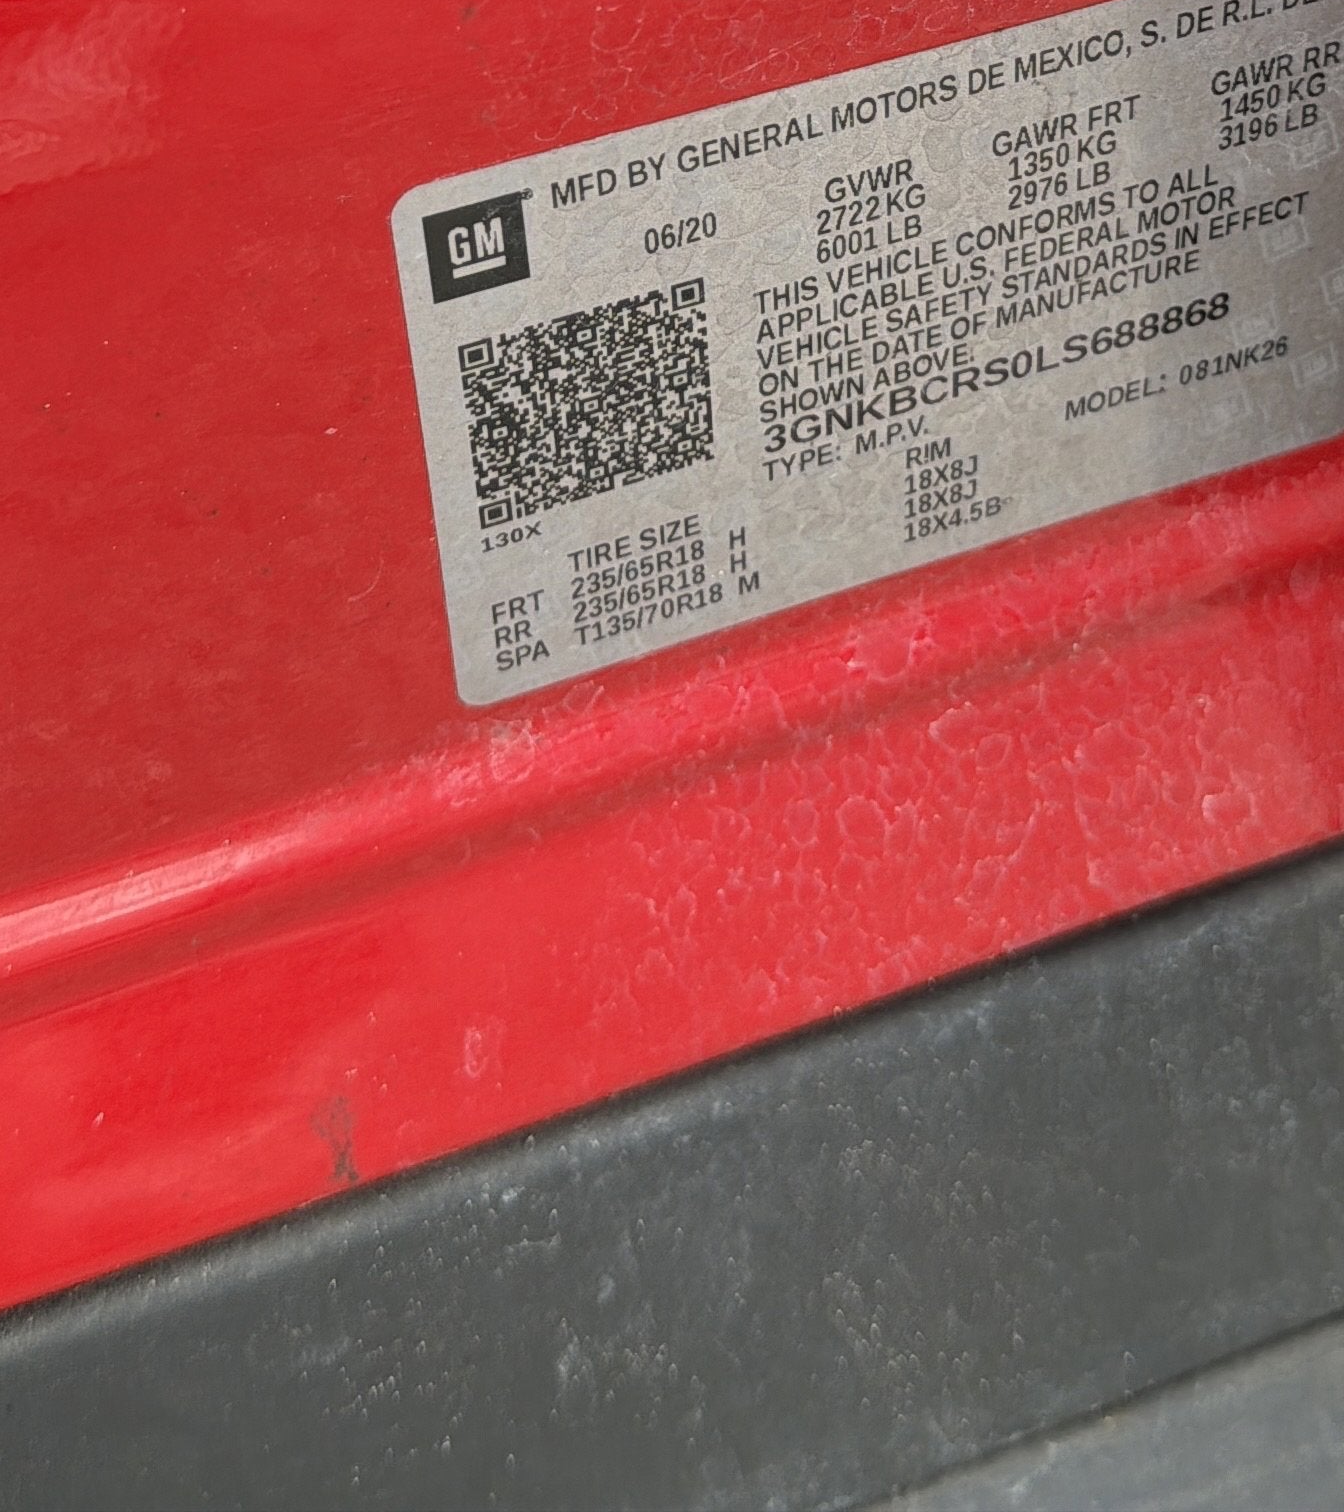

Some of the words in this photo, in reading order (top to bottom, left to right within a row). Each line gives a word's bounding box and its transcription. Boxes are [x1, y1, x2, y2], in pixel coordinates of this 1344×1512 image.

[1210, 53, 1294, 96] GAWR
[1302, 40, 1341, 73] RR
[1219, 83, 1282, 123] 1450
[1287, 71, 1326, 103] KG
[550, 168, 617, 209] MFD
[627, 152, 665, 188] BY
[676, 113, 824, 173] GENERAL
[831, 73, 958, 133] MOTORS
[968, 61, 1005, 96] DE
[1014, 29, 1132, 83] MEXICO,
[1140, 19, 1166, 48] S.
[1176, 4, 1214, 39] DE
[992, 112, 1077, 157] GAWR
[1088, 93, 1141, 132] FRT
[1218, 112, 1279, 151] 3196
[1284, 102, 1319, 133] LB
[824, 158, 913, 203] GVWR
[1008, 141, 1070, 182] 1350
[1077, 129, 1117, 162] KG
[1008, 171, 1068, 211] 2976
[1076, 160, 1111, 191] LB
[447, 216, 505, 266] GM
[643, 211, 717, 255] 06/20
[752, 275, 819, 314] THIS
[826, 238, 948, 294] VEHICLE
[955, 190, 1116, 257] CONFORMS
[1122, 178, 1160, 209] TO
[1167, 163, 1219, 198] ALL
[816, 195, 881, 236] 2722
[886, 183, 926, 216] KG
[816, 226, 879, 264] 6001
[886, 213, 922, 245] LB
[756, 270, 934, 344] APPLICABLE
[942, 255, 995, 289] U.S.
[1004, 216, 1130, 272] FEDERAL
[1137, 185, 1235, 234] MOTOR
[756, 314, 878, 370] VEHICLE
[885, 281, 992, 333] SAFETY
[1001, 230, 1167, 299] STANDARDS
[1174, 222, 1199, 250] IN
[1208, 190, 1310, 240] EFFECT
[758, 365, 799, 397] ON
[807, 346, 863, 383] THE
[872, 323, 943, 365] DATE
[950, 310, 986, 341] OF
[996, 248, 1201, 329] MANUFACTURE
[759, 373, 864, 424] SHOWN
[872, 342, 974, 391] ABOVE.
[764, 291, 1231, 453] 3GNKBCRS0LS688868
[1064, 373, 1167, 421] MODEL:
[1179, 334, 1289, 386] 081NK26
[761, 442, 841, 482] TYPE:
[855, 414, 929, 455] M.P.V.
[481, 520, 542, 553] 130X
[491, 588, 544, 625] FRT
[571, 539, 705, 600] 235/65R18
[728, 526, 746, 550] H
[904, 454, 978, 495] 18X8J
[494, 619, 532, 649] RR
[572, 563, 706, 624] 235/65R18
[729, 549, 747, 574] H
[904, 478, 977, 519] 18X8J
[566, 535, 632, 572] TIRE
[639, 514, 701, 551] SIZE
[495, 639, 550, 672] SPA
[573, 582, 723, 645] T135/70R18
[738, 570, 760, 595] M
[904, 495, 1002, 543] 18X4.5B
